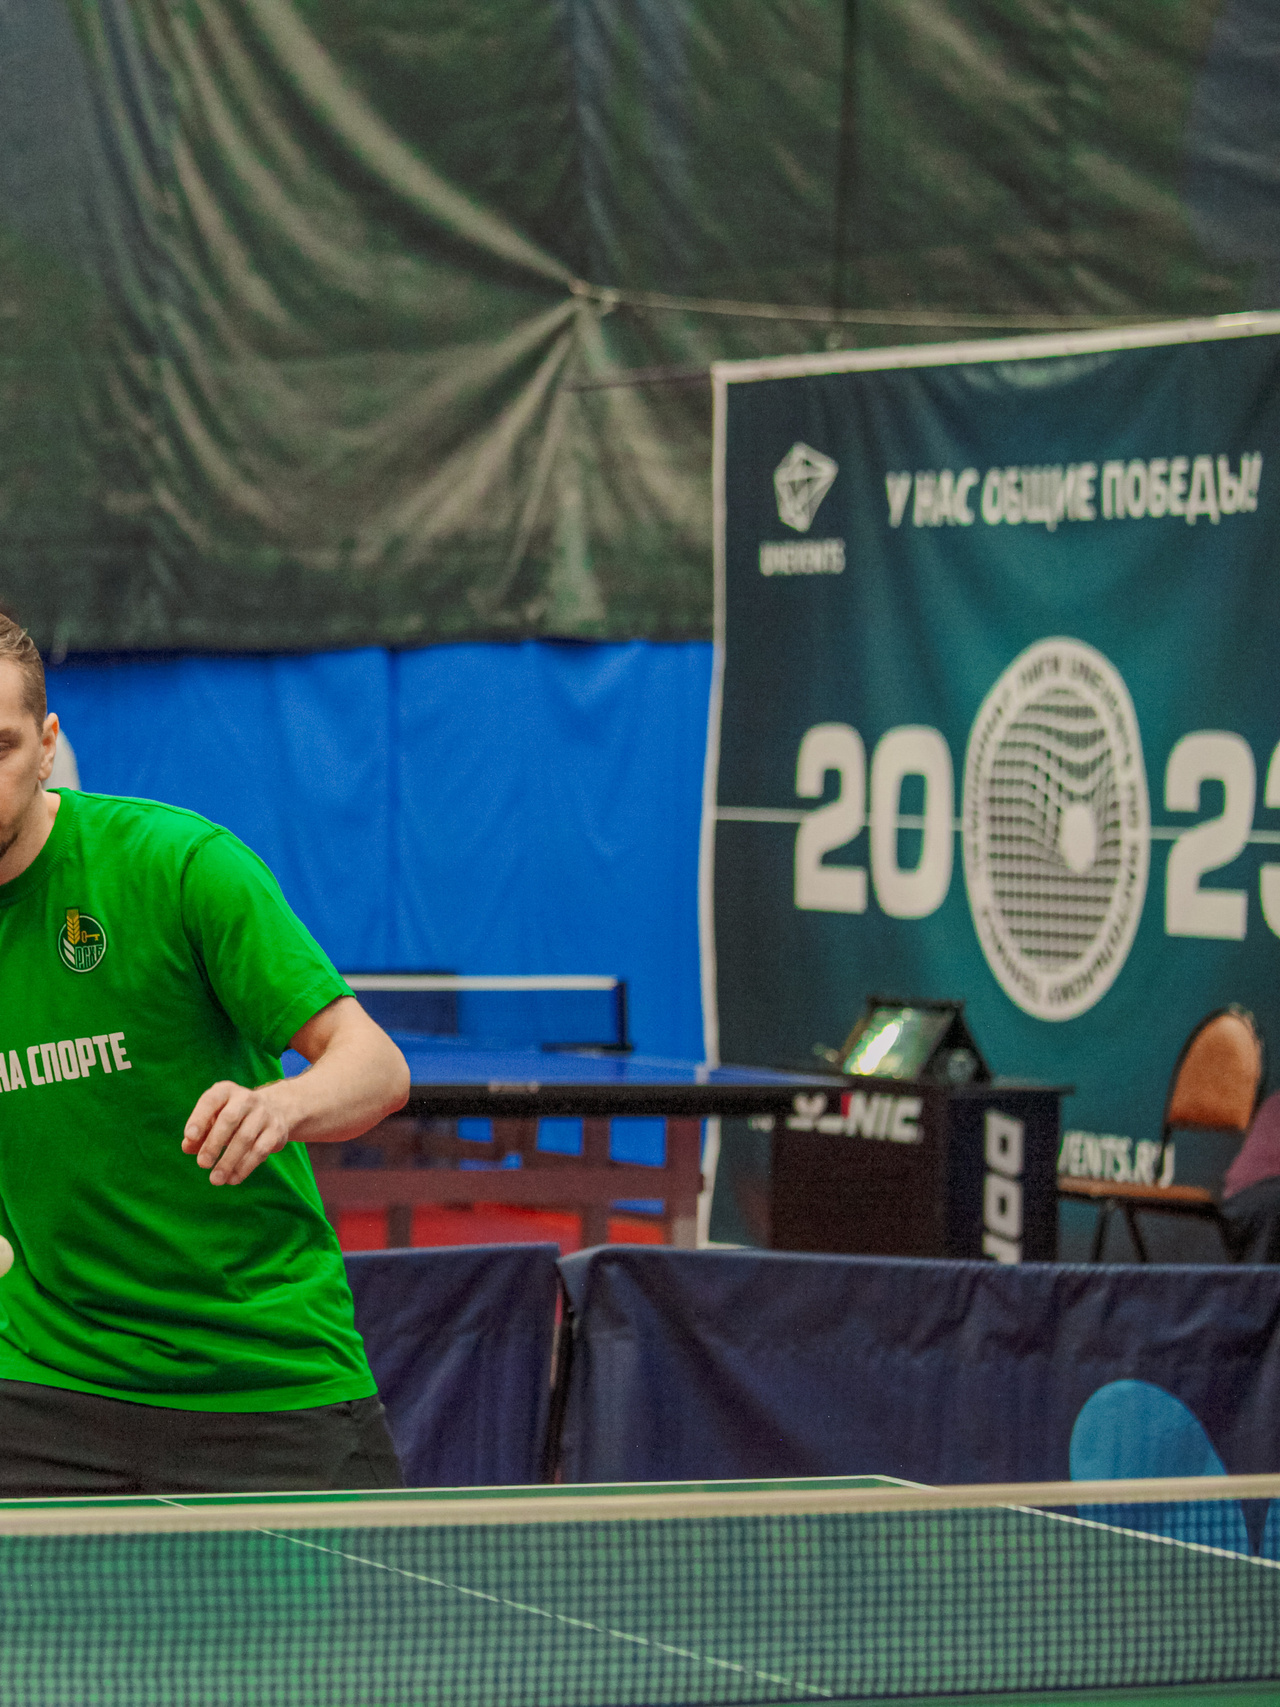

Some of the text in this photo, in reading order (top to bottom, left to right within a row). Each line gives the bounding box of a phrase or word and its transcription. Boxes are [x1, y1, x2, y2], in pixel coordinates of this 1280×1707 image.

[885, 451, 1263, 533] У НАС ОБЩИЕ ПОБЕДЫ!
[794, 721, 955, 920] 20
[1164, 728, 1280, 942] 2
[26, 1031, 132, 1086] СПОРТЕ
